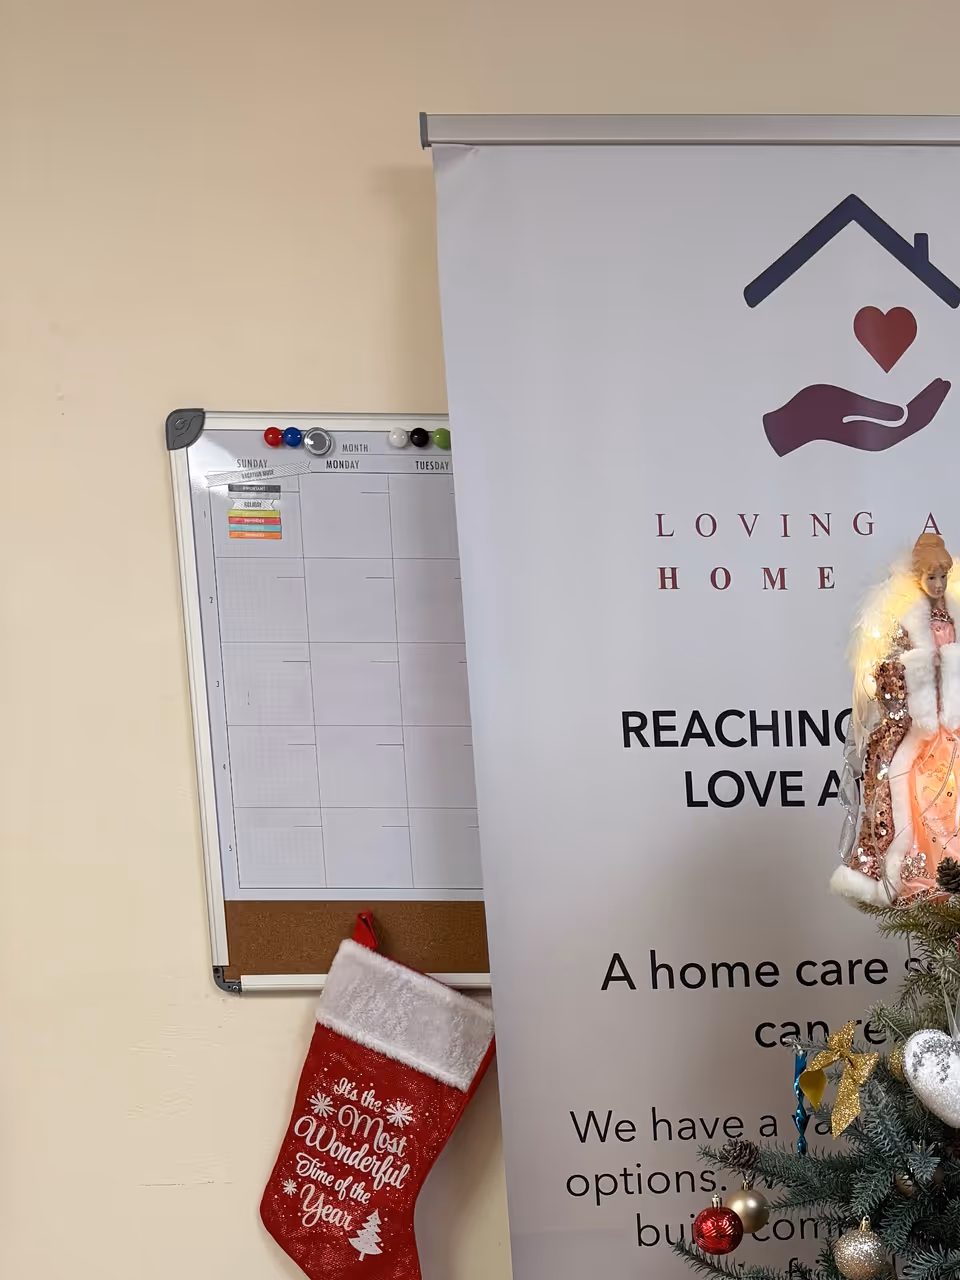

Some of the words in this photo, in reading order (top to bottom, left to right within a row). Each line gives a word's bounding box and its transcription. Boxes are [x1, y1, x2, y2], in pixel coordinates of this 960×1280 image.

[237, 459, 268, 468] SUNDAY
[326, 460, 360, 469] MONDAY
[415, 460, 449, 470] TUESDAY
[342, 443, 369, 453] MONTH
[655, 510, 875, 538] LOVING
[656, 565, 836, 591] HOME
[684, 769, 806, 809] LOVE
[600, 952, 637, 991] A
[650, 949, 780, 990] home
[796, 957, 889, 987] care
[755, 1019, 830, 1048] can
[333, 1078, 358, 1101] It's
[361, 1089, 382, 1112] the
[338, 1104, 408, 1158] Most
[570, 1109, 637, 1144] We
[652, 1106, 744, 1141] have
[759, 1114, 778, 1137] a
[294, 1115, 411, 1191] Wonderful
[295, 1152, 335, 1187] Time
[335, 1175, 350, 1200] of
[350, 1181, 371, 1205] the
[566, 1162, 727, 1207] options.
[300, 1183, 353, 1231] Year
